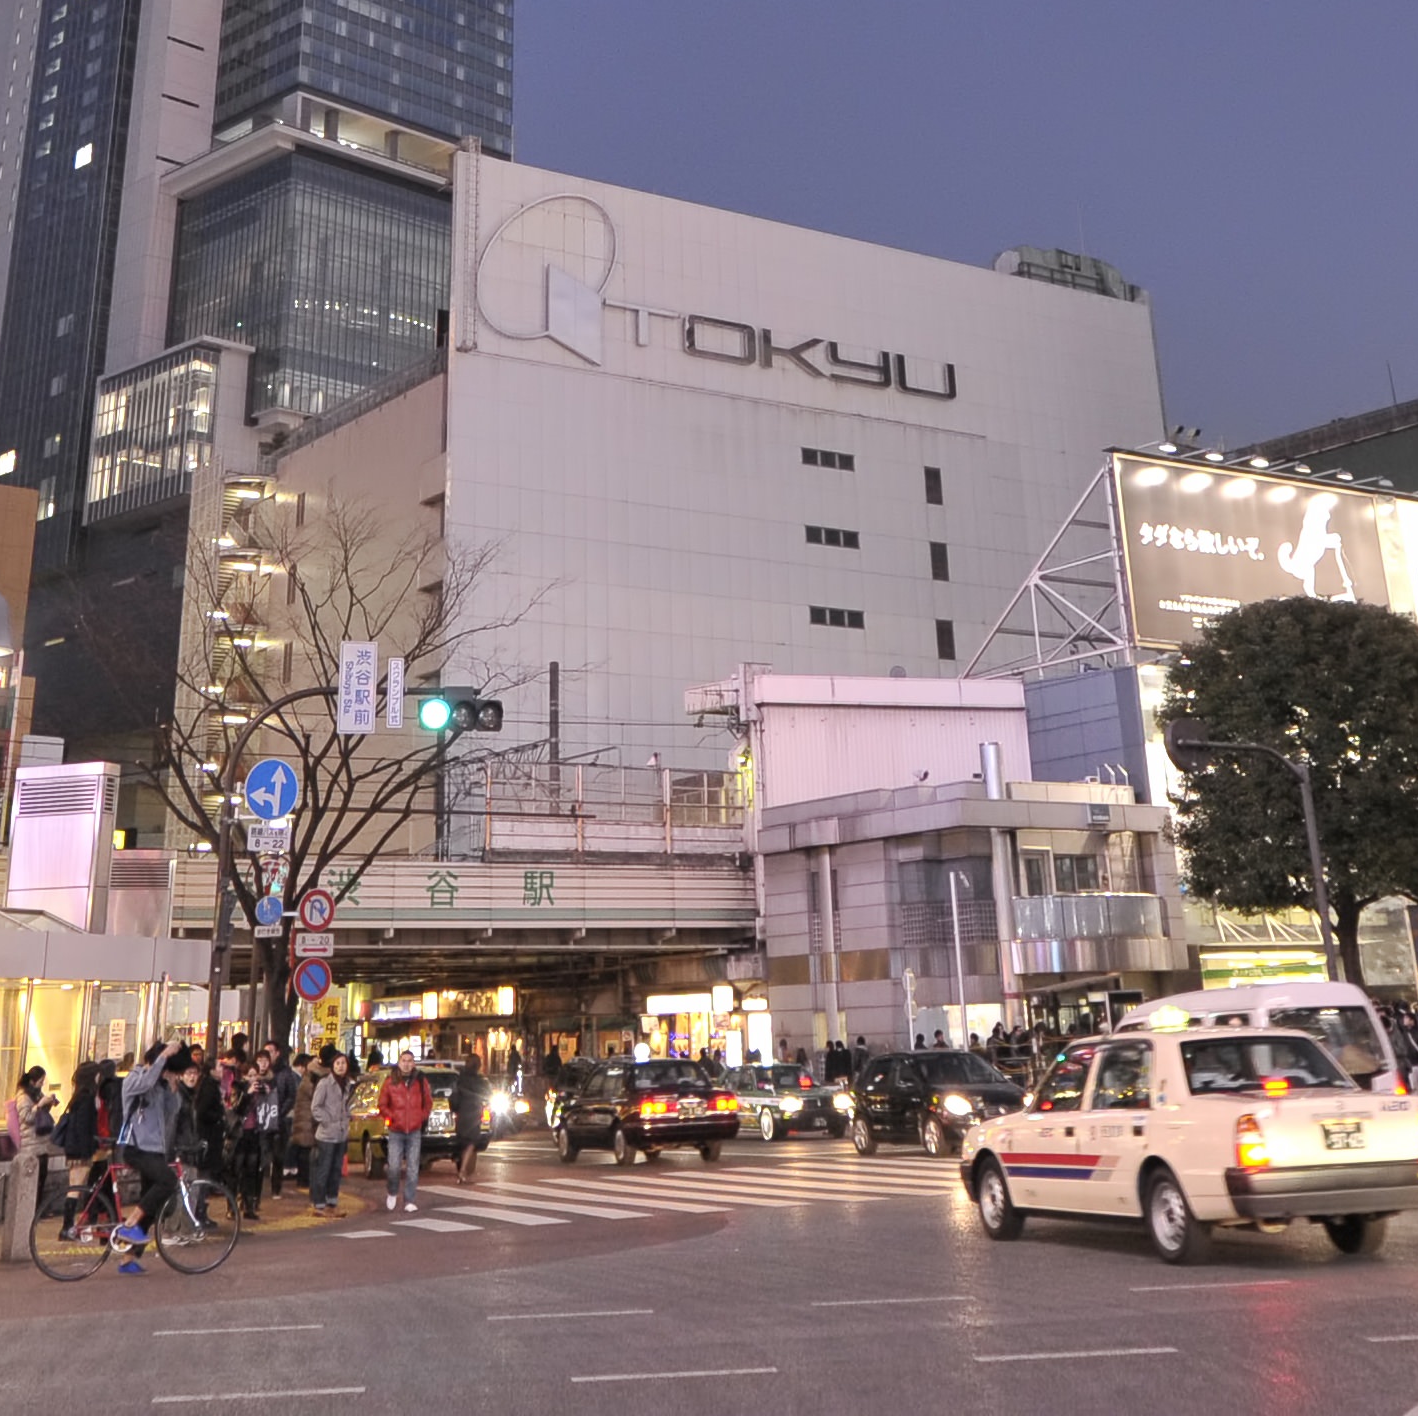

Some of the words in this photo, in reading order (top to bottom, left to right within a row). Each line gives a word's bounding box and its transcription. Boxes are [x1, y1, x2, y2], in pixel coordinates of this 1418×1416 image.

[602, 294, 957, 401] TOKYU
[344, 661, 355, 696] Shibuya
[354, 649, 372, 726] 渋谷駅前
[327, 868, 556, 907] 渋谷駅
